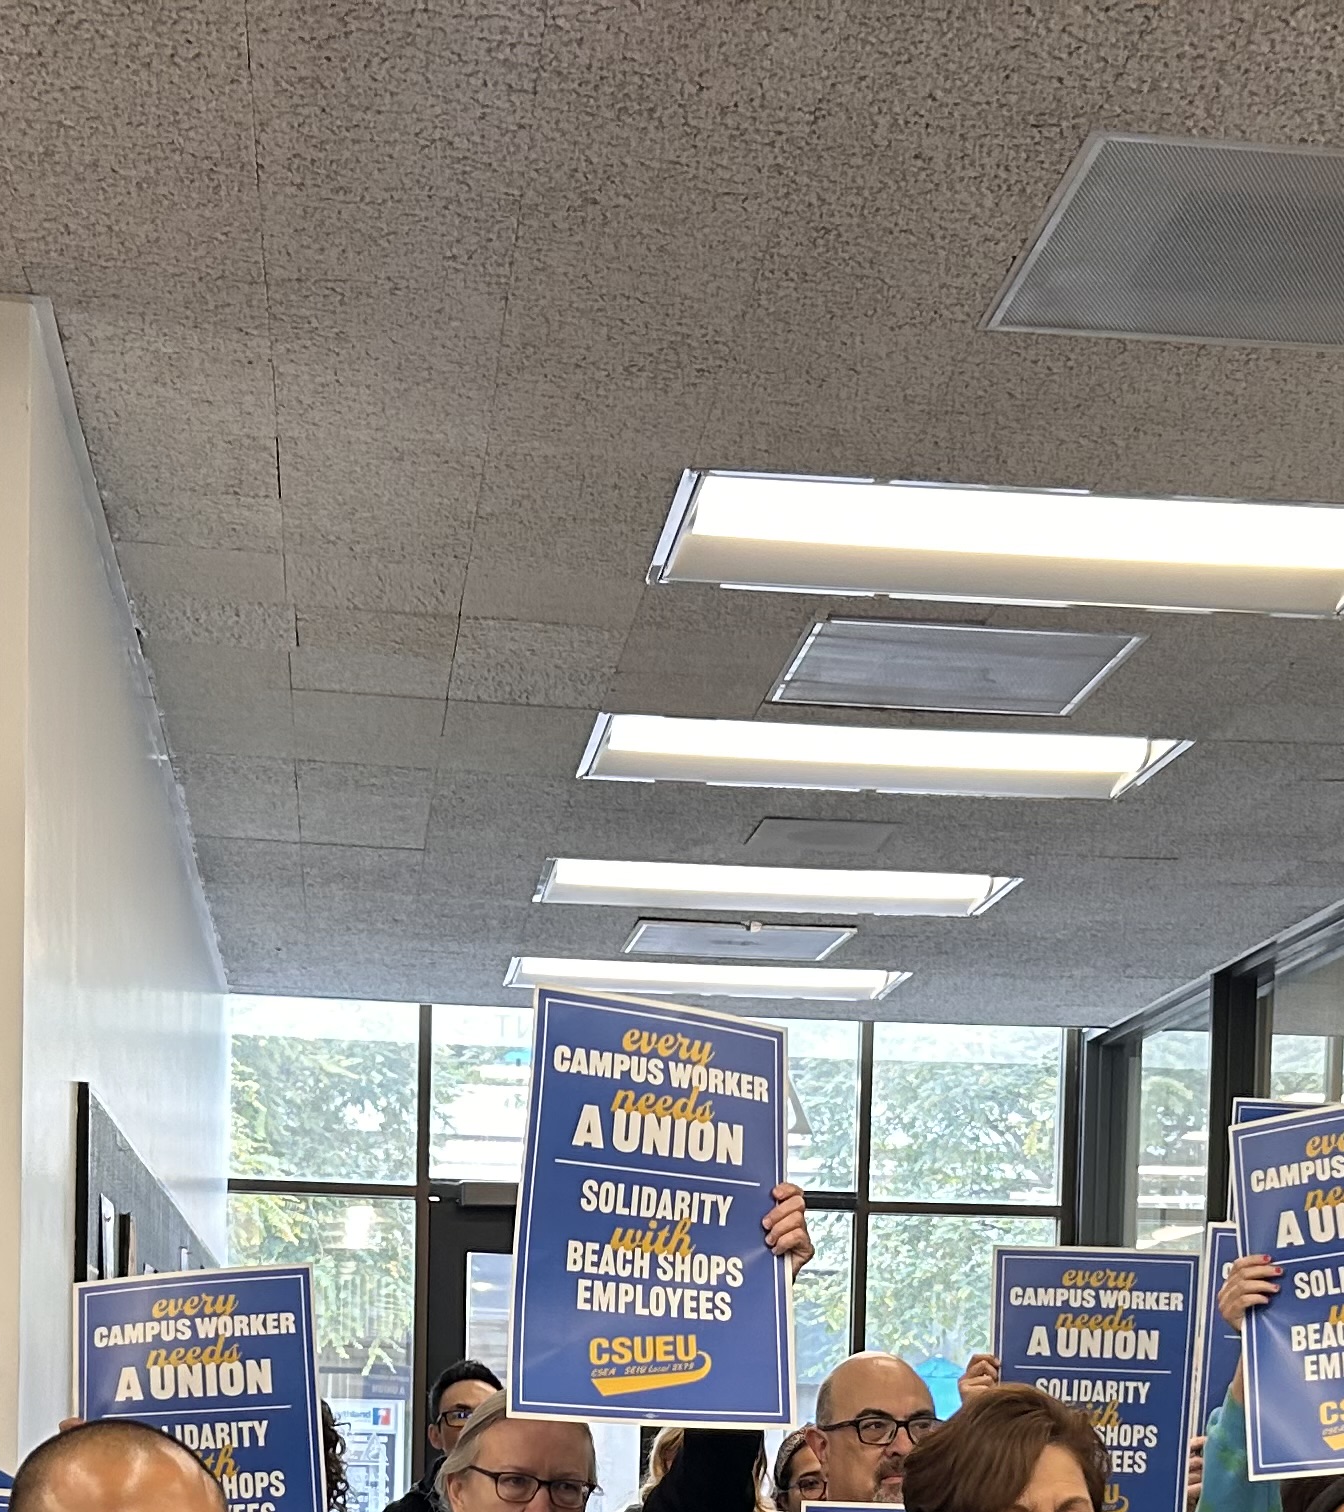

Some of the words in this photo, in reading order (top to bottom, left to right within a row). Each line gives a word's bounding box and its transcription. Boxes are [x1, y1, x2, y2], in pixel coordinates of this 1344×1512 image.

[622, 1027, 717, 1065] every
[555, 1045, 663, 1085] CAMPUS
[669, 1062, 769, 1103] WORKER
[610, 1085, 715, 1124] needs
[572, 1104, 604, 1149] A
[613, 1108, 744, 1166] UNION
[580, 1179, 734, 1226] SOLIDARITY
[610, 1217, 696, 1258] with
[1276, 1210, 1305, 1248] A
[567, 1240, 650, 1281] BEACH
[657, 1252, 743, 1288] SHOPS
[1062, 1268, 1137, 1292] every
[152, 1292, 239, 1319] every
[576, 1278, 731, 1322] EMPLOYEES
[1010, 1287, 1096, 1309] CAMPUS
[1099, 1290, 1183, 1311] WORKER
[94, 1318, 192, 1348] CAMPUS
[196, 1313, 296, 1339] WORKER
[1055, 1306, 1136, 1332] needs
[147, 1335, 241, 1369] needs
[590, 1334, 697, 1366] CSUEU
[1027, 1326, 1052, 1357] A
[1057, 1328, 1158, 1360] UNION
[115, 1366, 144, 1402] A
[149, 1359, 273, 1399] UNION
[218, 1471, 286, 1499] HOPS
